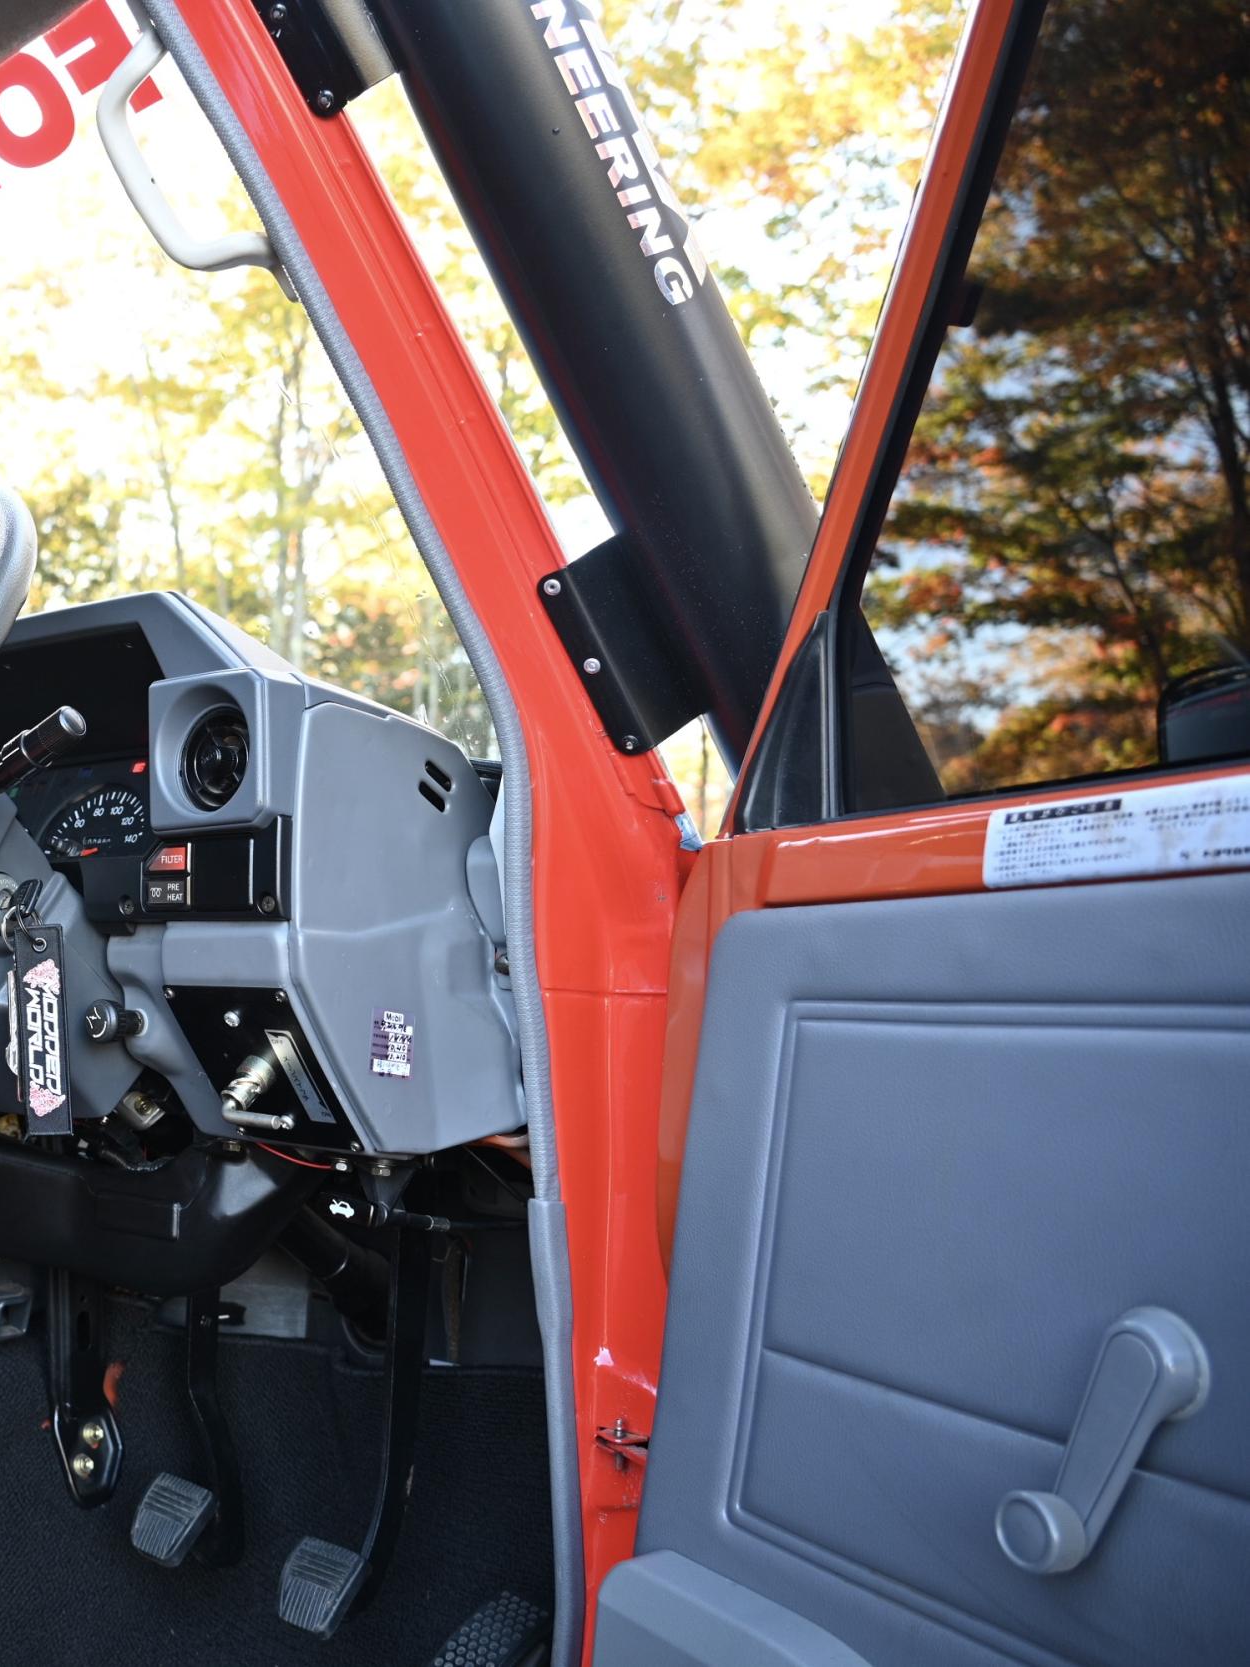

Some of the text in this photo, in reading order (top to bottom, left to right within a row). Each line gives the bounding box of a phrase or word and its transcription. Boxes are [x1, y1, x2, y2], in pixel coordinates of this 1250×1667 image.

[93, 807, 104, 817] 80
[110, 806, 124, 815] 100
[74, 819, 85, 828] 60
[121, 816, 134, 826] 120
[124, 833, 138, 843] 140
[161, 855, 183, 864] FILTER
[167, 883, 180, 891] PRE
[167, 893, 183, 901] HEAT
[24, 987, 45, 1086] WORLD
[41, 980, 62, 1095] MODDED
